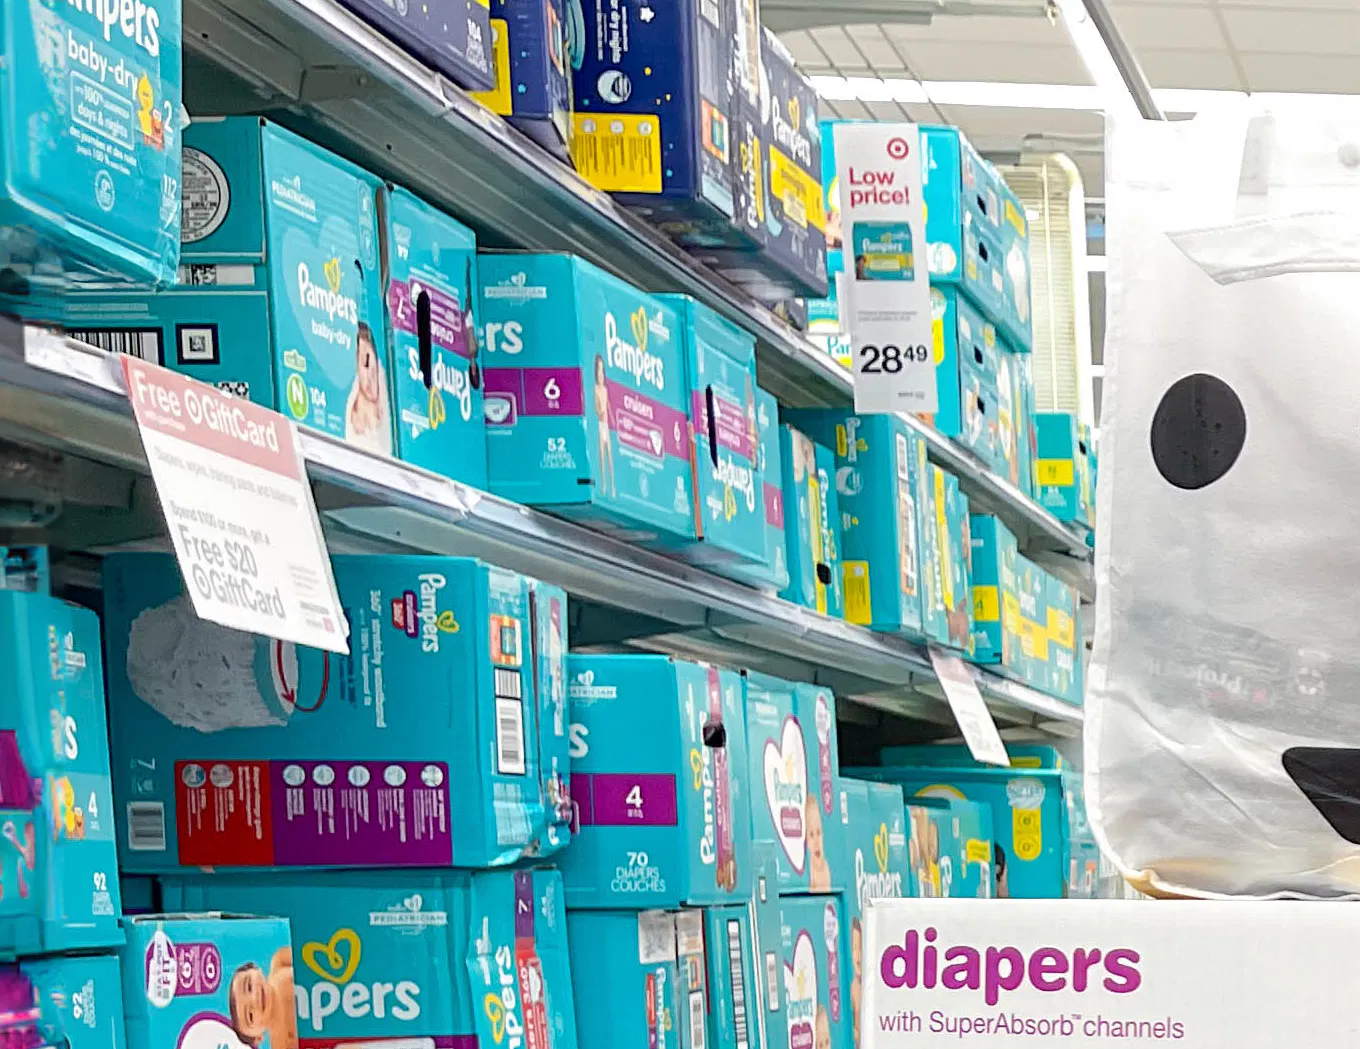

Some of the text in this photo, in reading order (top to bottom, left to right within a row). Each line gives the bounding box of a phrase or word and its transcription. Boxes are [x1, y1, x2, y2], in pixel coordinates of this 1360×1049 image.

[68, 31, 138, 100] baby-dry
[849, 167, 895, 186] Low
[849, 186, 910, 208] price!
[298, 261, 358, 325] Pampers
[604, 312, 664, 391] Pampers
[133, 370, 181, 414] Free
[544, 377, 561, 400] 6
[547, 438, 566, 452] 52
[178, 524, 258, 578] Free $20
[418, 572, 446, 653] Pampers
[626, 784, 644, 808] 4
[627, 852, 648, 867] 70
[93, 873, 107, 891] 92
[616, 866, 659, 880] DIAPERS
[611, 879, 665, 892] COUCHES
[879, 926, 1142, 1006] diapers
[879, 1011, 922, 1032] with
[1083, 1015, 1185, 1039] channels
